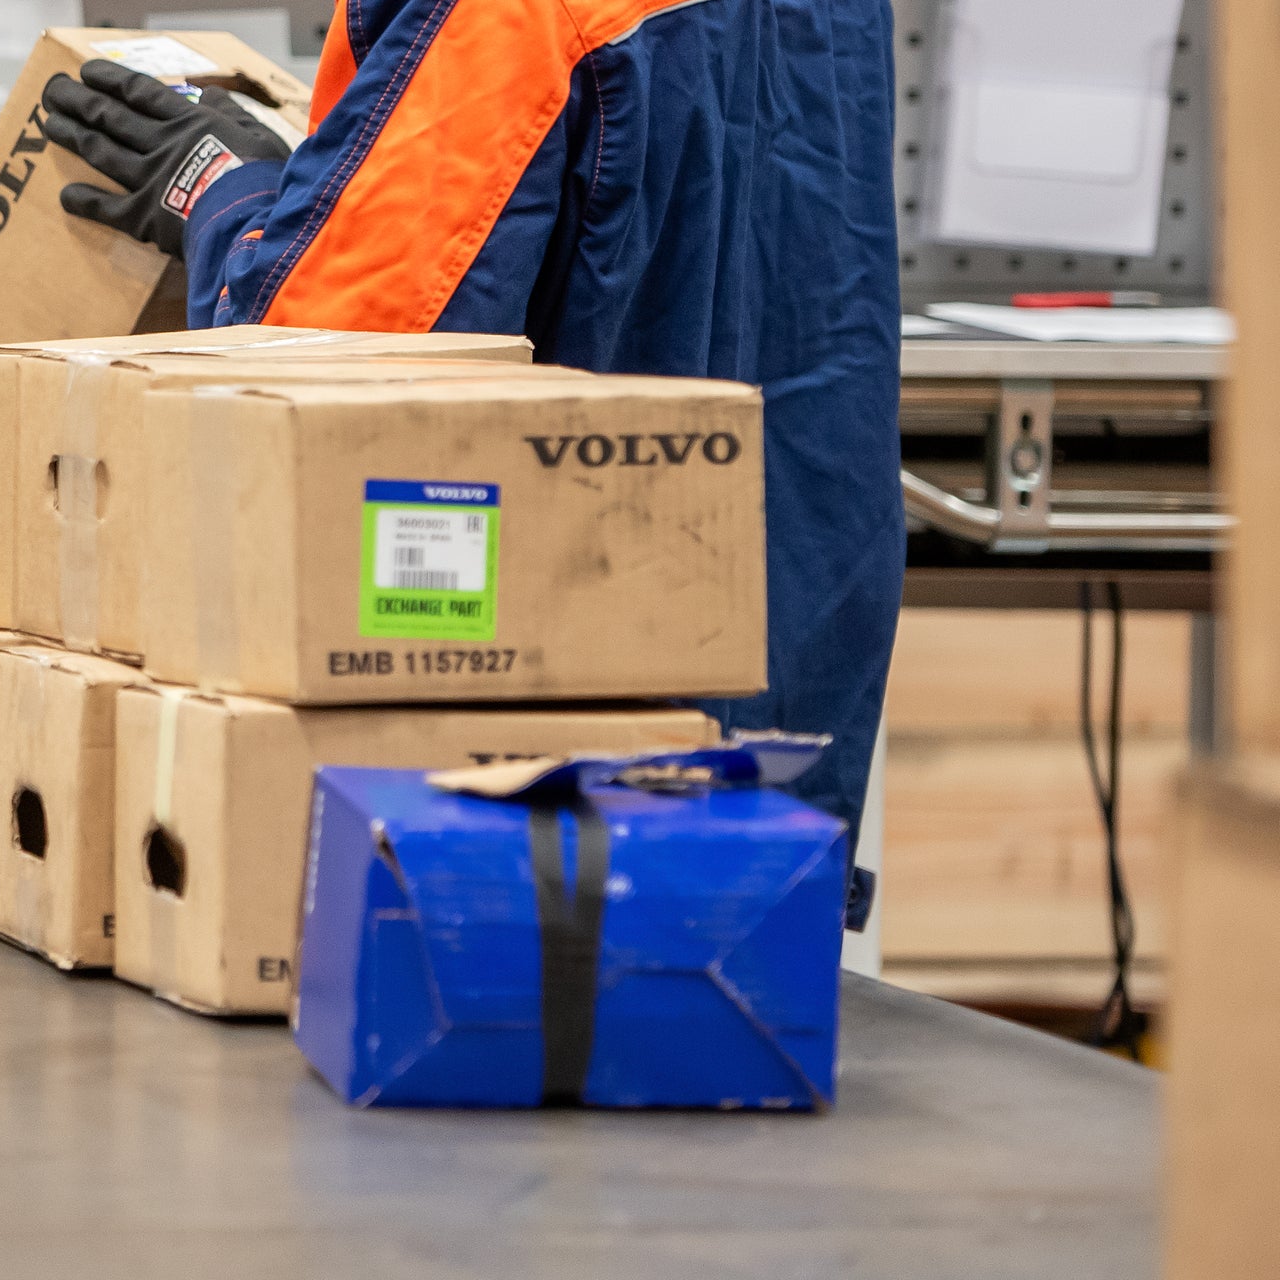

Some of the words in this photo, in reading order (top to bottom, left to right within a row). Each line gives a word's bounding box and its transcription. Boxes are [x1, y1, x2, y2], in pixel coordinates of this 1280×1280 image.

[525, 431, 742, 468] VOLVO
[424, 486, 488, 501] VOLVO
[376, 597, 442, 616] EXCHANGE
[450, 600, 481, 617] PART
[328, 651, 394, 675] EMB
[404, 650, 517, 674] 1157927
